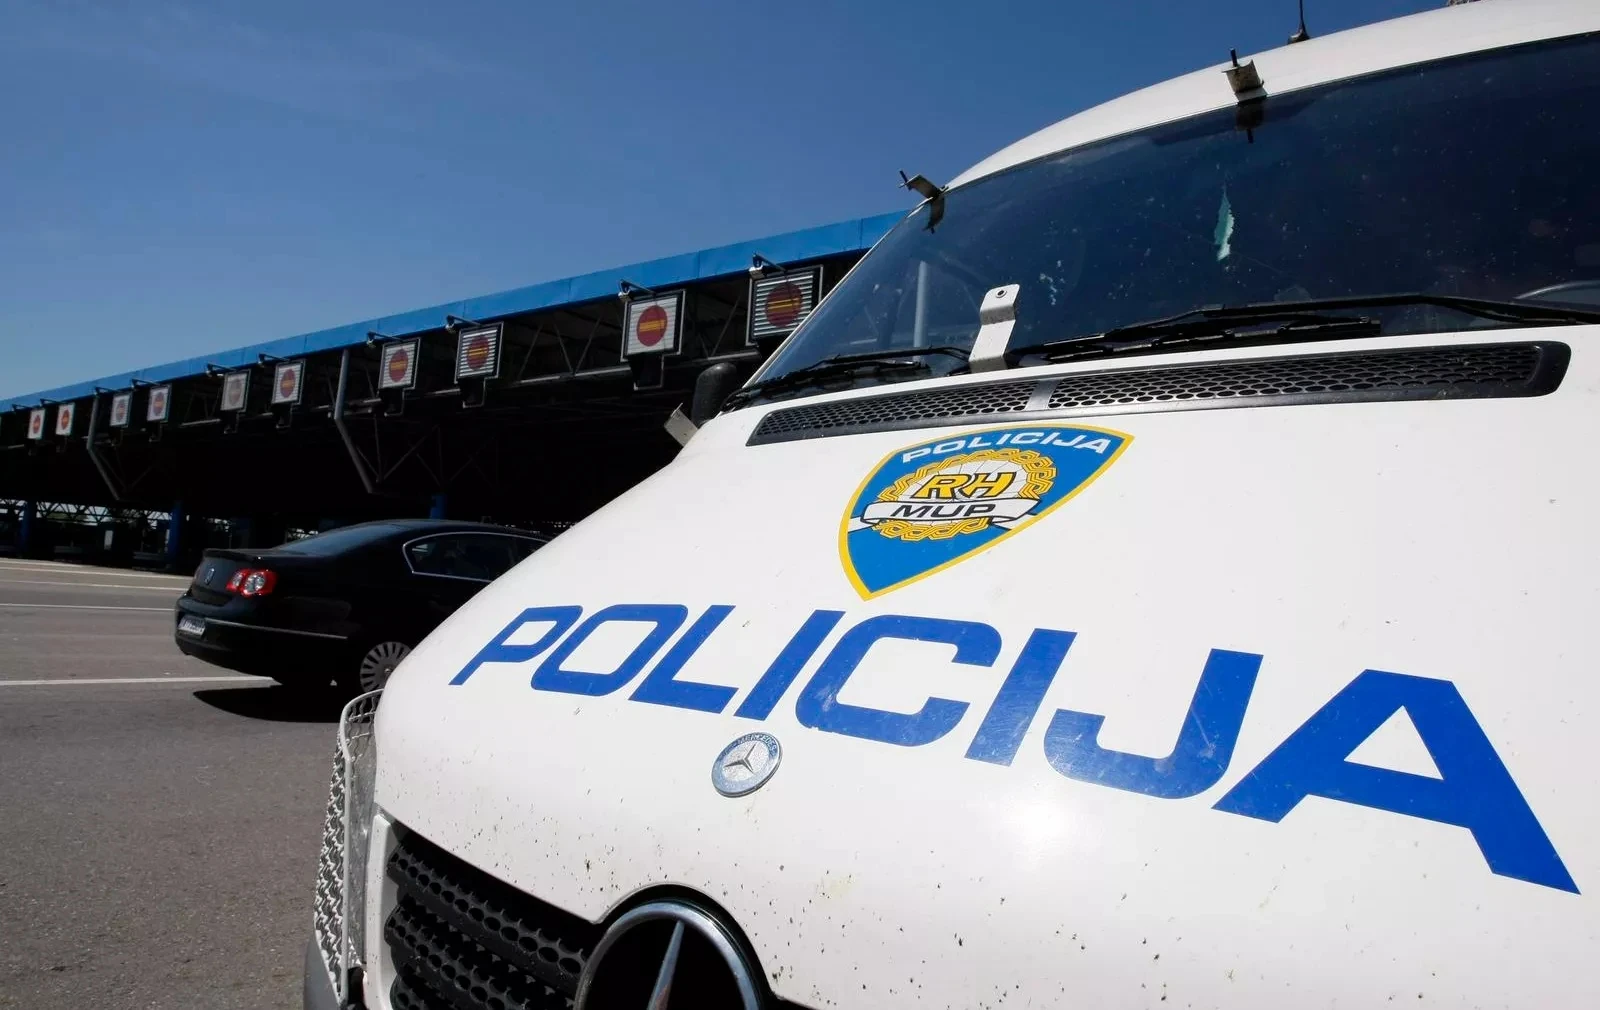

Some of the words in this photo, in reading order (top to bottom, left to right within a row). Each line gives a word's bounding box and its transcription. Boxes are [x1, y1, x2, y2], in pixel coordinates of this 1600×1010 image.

[902, 431, 1111, 464] POLICIJA
[917, 472, 1016, 499] RH
[890, 503, 996, 518] MUP
[448, 603, 1581, 895] POLICIJA
